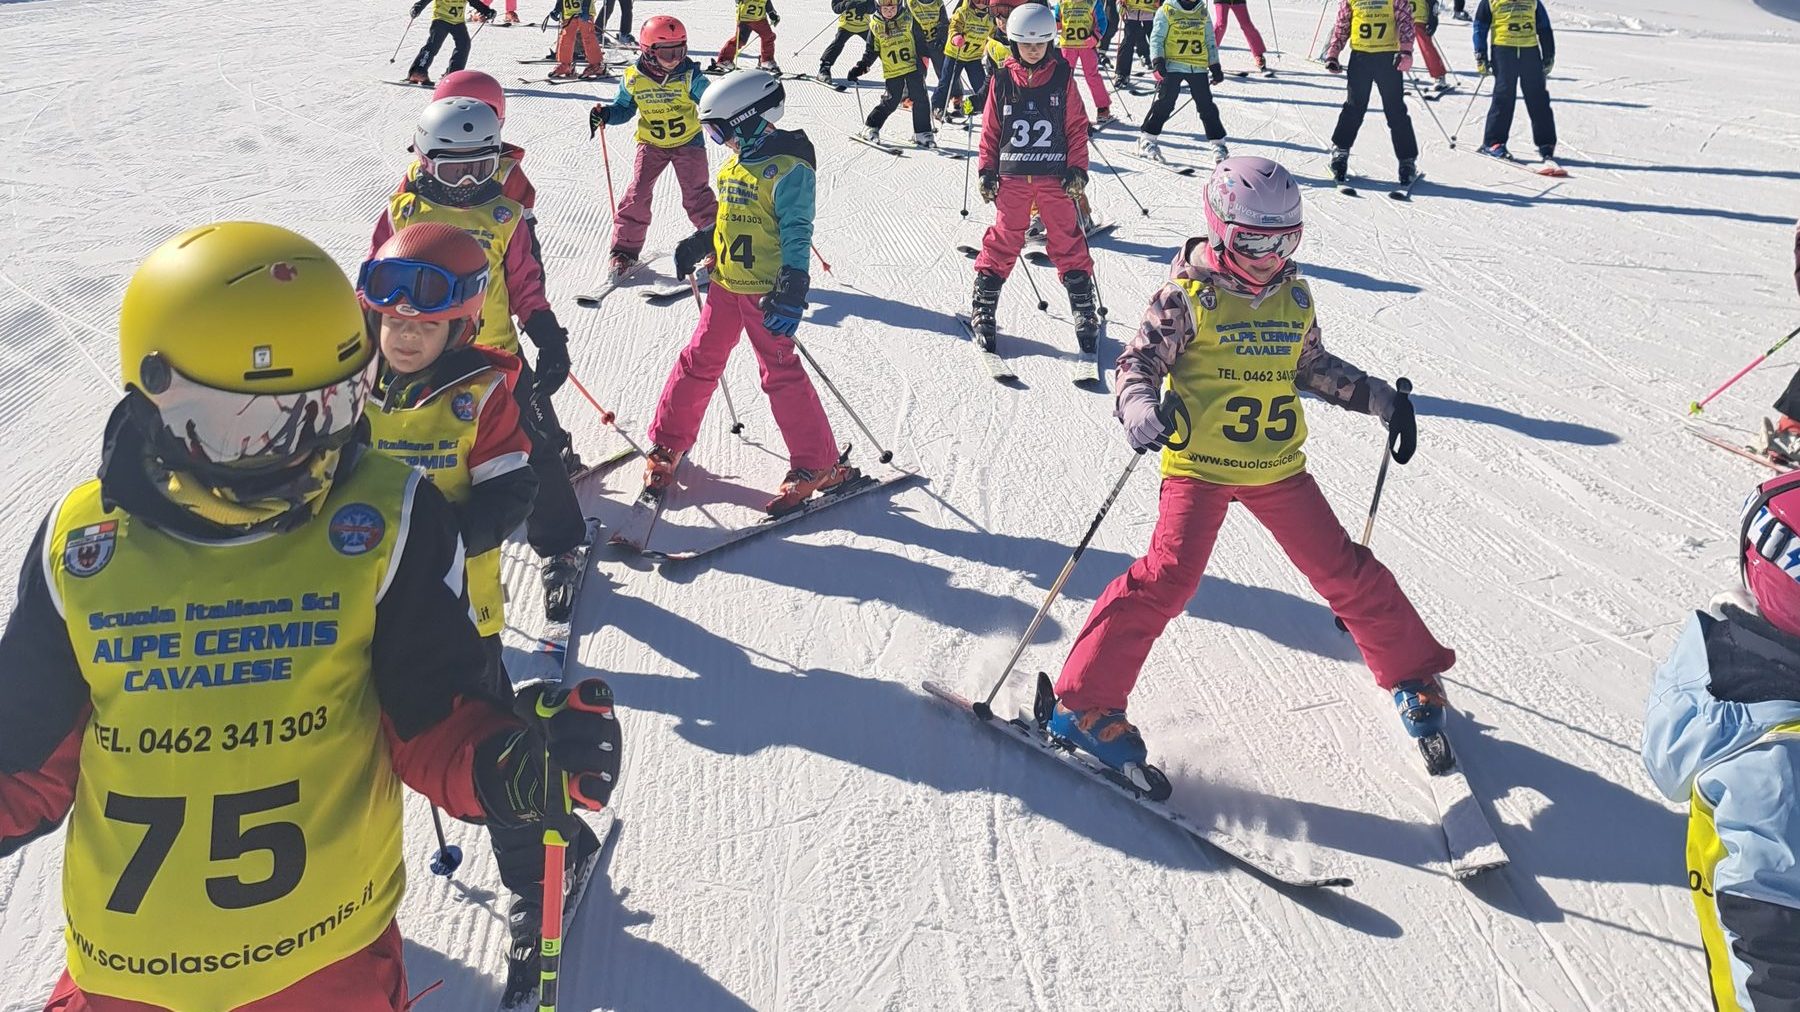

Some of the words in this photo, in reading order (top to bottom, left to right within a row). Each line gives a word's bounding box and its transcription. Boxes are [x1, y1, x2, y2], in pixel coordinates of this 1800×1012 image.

[449, 6, 464, 18] 47
[746, 4, 763, 16] 27
[1066, 27, 1090, 40] 20
[1360, 23, 1387, 39] 97
[1176, 39, 1203, 54] 73
[886, 47, 911, 65] 16
[650, 116, 687, 140] 55
[1010, 119, 1053, 148] 32
[731, 213, 763, 225] 341303
[1236, 202, 1258, 220] uvex
[1219, 331, 1257, 345] ALPE
[1217, 367, 1241, 381] TEL.
[1243, 370, 1274, 382] 0462
[1222, 395, 1298, 443] 35
[89, 605, 177, 631] Scuola
[185, 597, 293, 621] Italiana
[301, 592, 341, 611] Sci
[92, 632, 182, 664] ALPE
[194, 620, 339, 657] CERMIS
[123, 656, 293, 693] CAVALESE
[138, 725, 212, 754] 0462
[221, 705, 328, 750] 341303
[104, 778, 308, 915] 75
